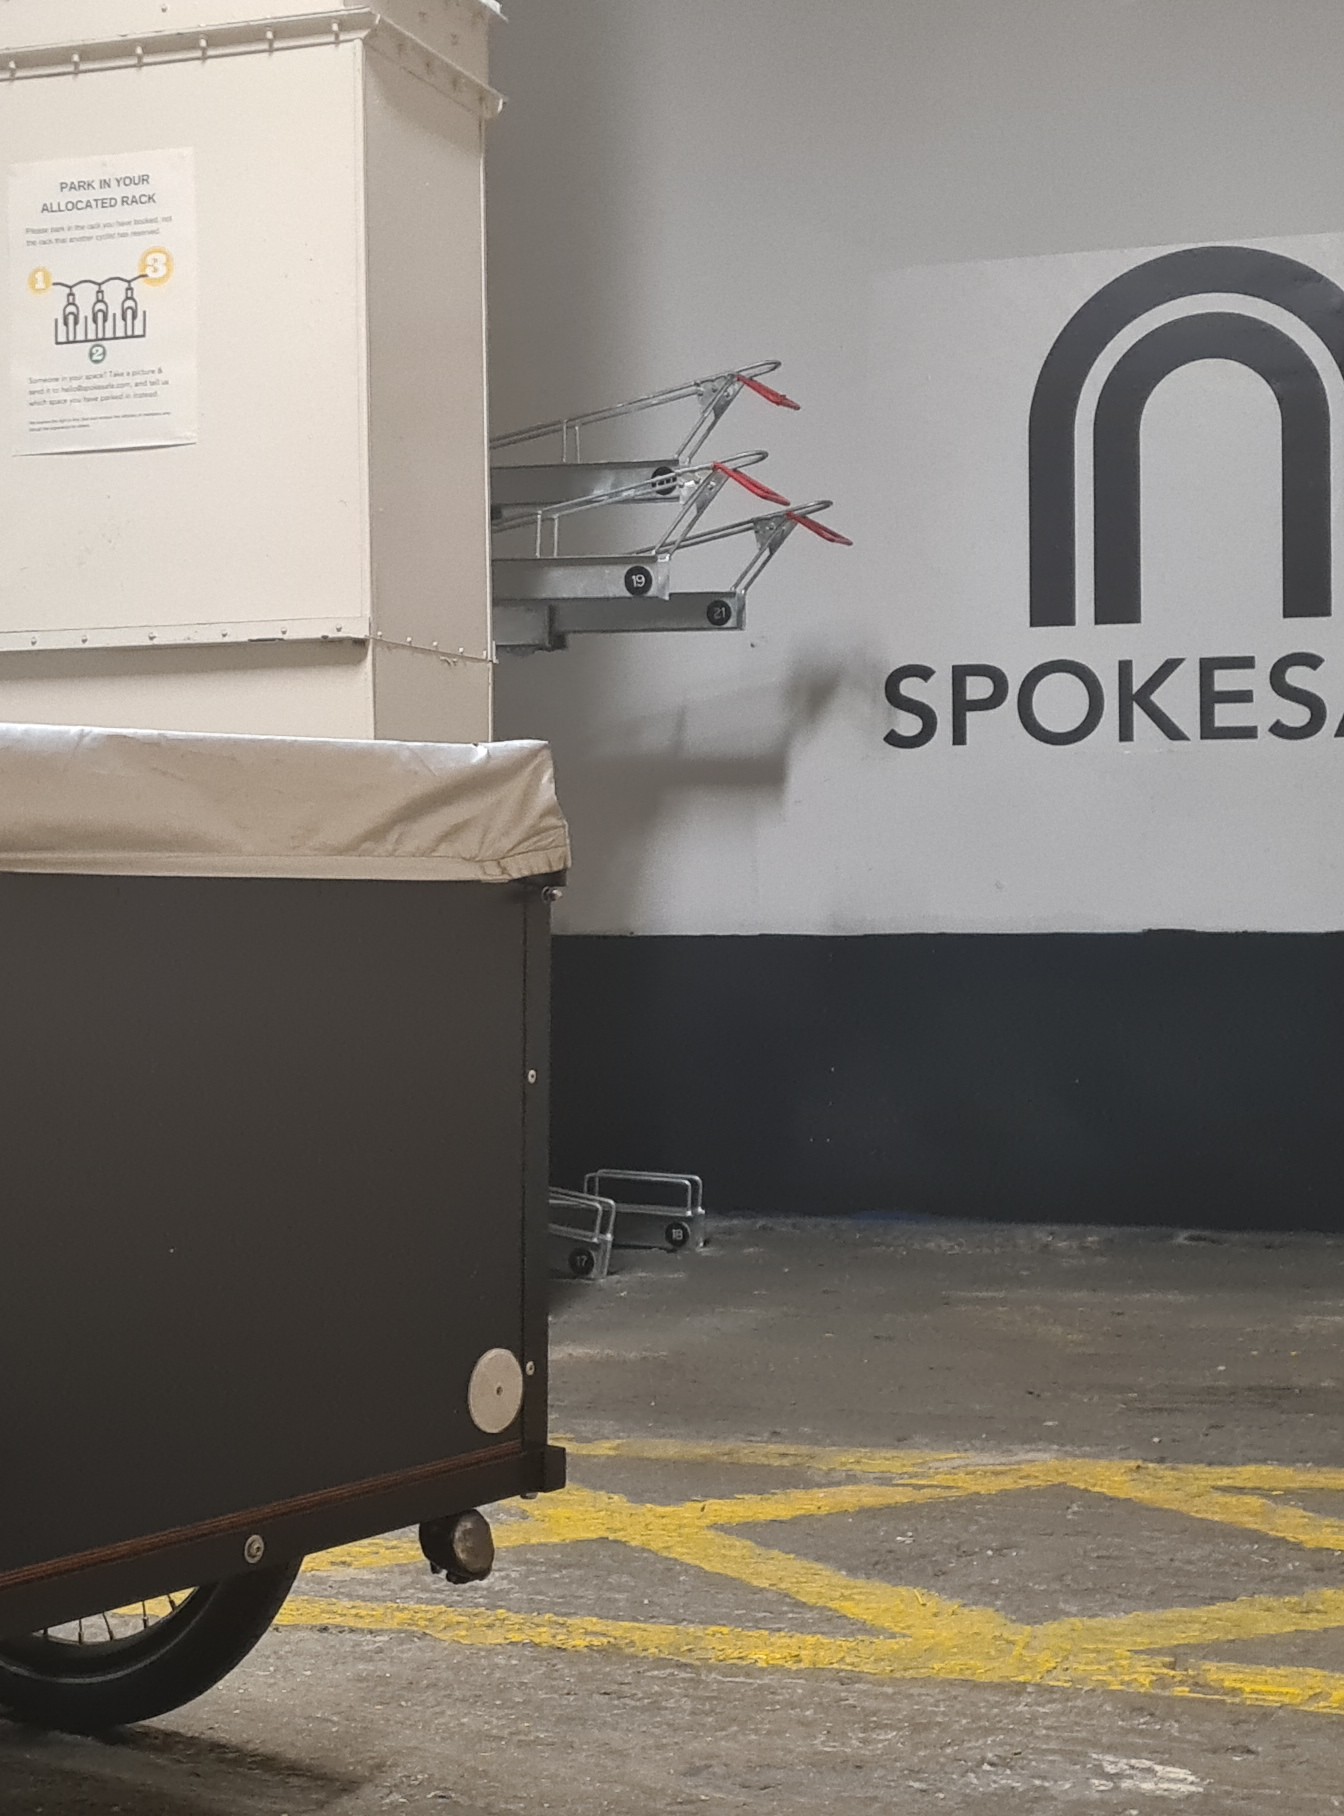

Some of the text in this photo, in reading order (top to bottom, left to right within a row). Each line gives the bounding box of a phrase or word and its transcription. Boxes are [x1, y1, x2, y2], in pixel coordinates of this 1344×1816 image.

[60, 174, 150, 192] PARK IN YOUR
[41, 193, 156, 213] ALLOCATED RACK
[145, 252, 167, 278] 3
[34, 271, 46, 289] 1
[91, 346, 103, 360] 2
[631, 574, 646, 587] 19
